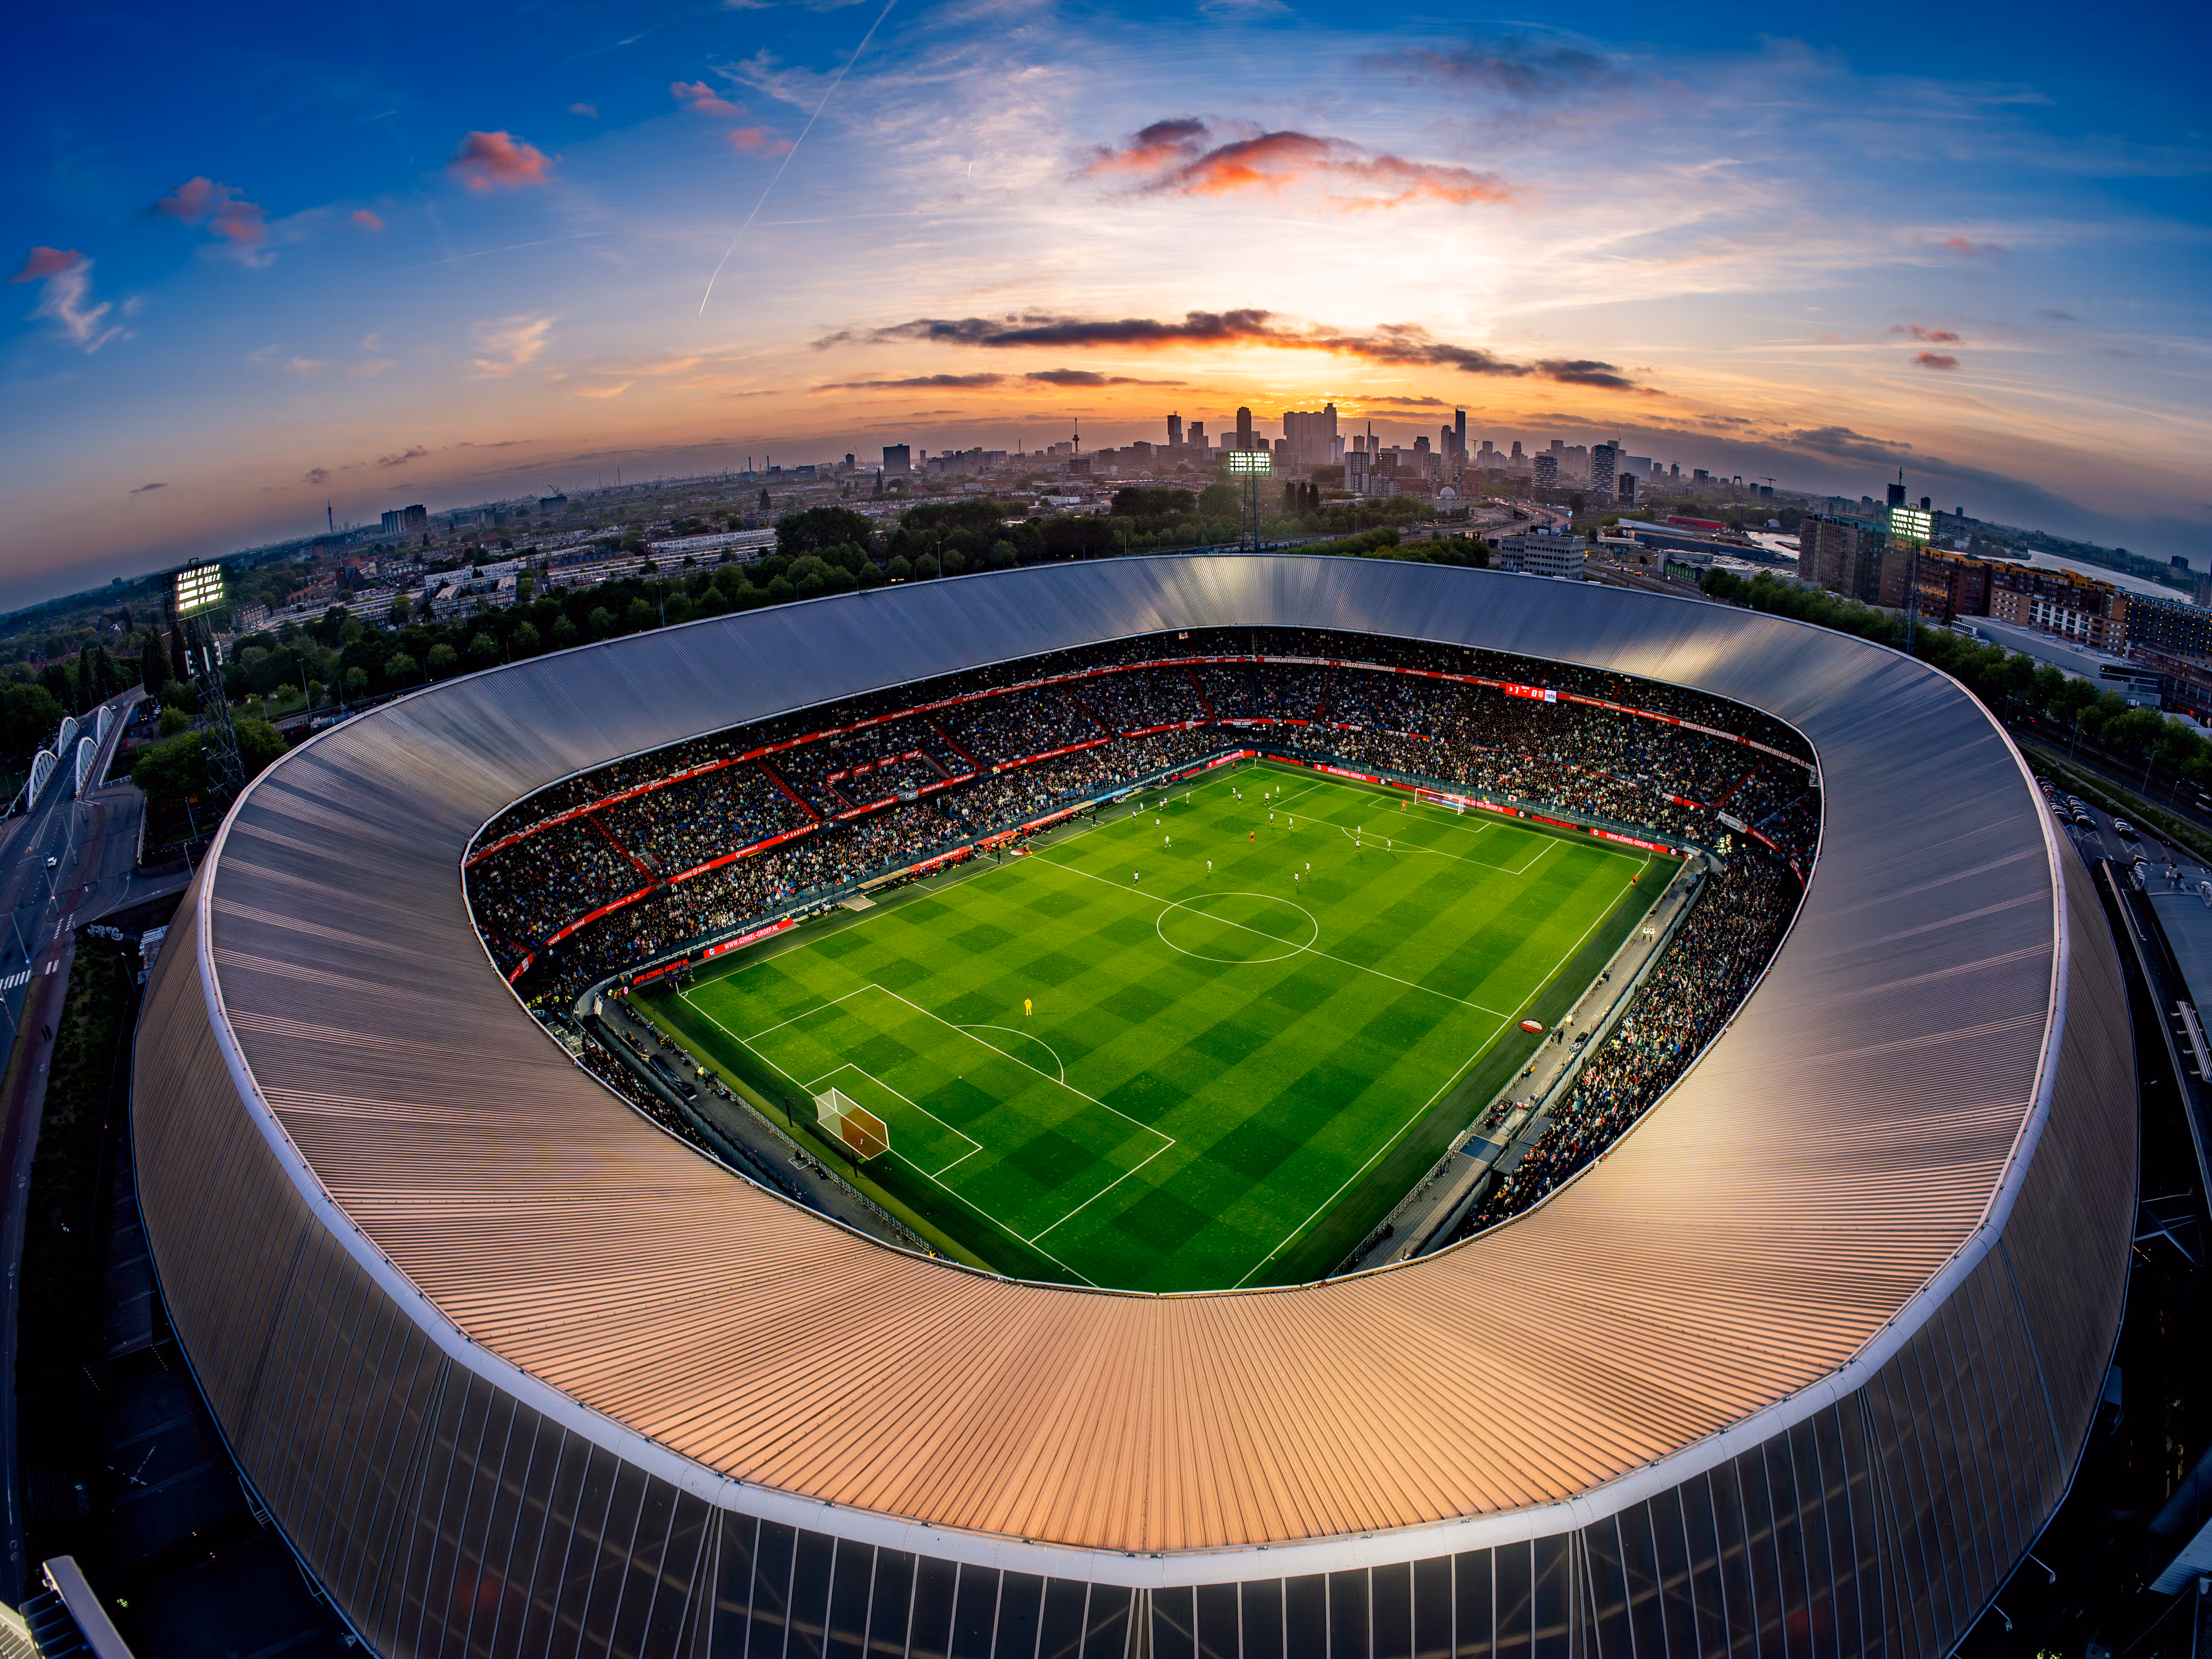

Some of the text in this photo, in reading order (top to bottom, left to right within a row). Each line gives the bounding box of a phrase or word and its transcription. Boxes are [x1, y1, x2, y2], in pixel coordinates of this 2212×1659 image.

[1358, 664, 1396, 672] BEKERWINNAAR
[1515, 686, 1537, 697] 1 0
[933, 700, 952, 709] CASTORE
[1684, 721, 1698, 730] KEER
[1697, 725, 1738, 742] LANDSKAMPIOEN
[1749, 740, 1772, 753] WINNAAR
[1771, 748, 1783, 758] UEFA
[1782, 752, 1791, 760] CUP
[1790, 756, 1801, 765] 1974
[1328, 767, 1367, 781] WWW.GINKEL-GROEP.NL
[790, 825, 813, 837] CASTORE
[490, 841, 506, 852] Quooker
[1607, 832, 1654, 850] WWW.GINKEL-GROEP.NL
[571, 918, 585, 931] univé
[724, 924, 779, 950] WWW.GINKEL-GROEP.NL
